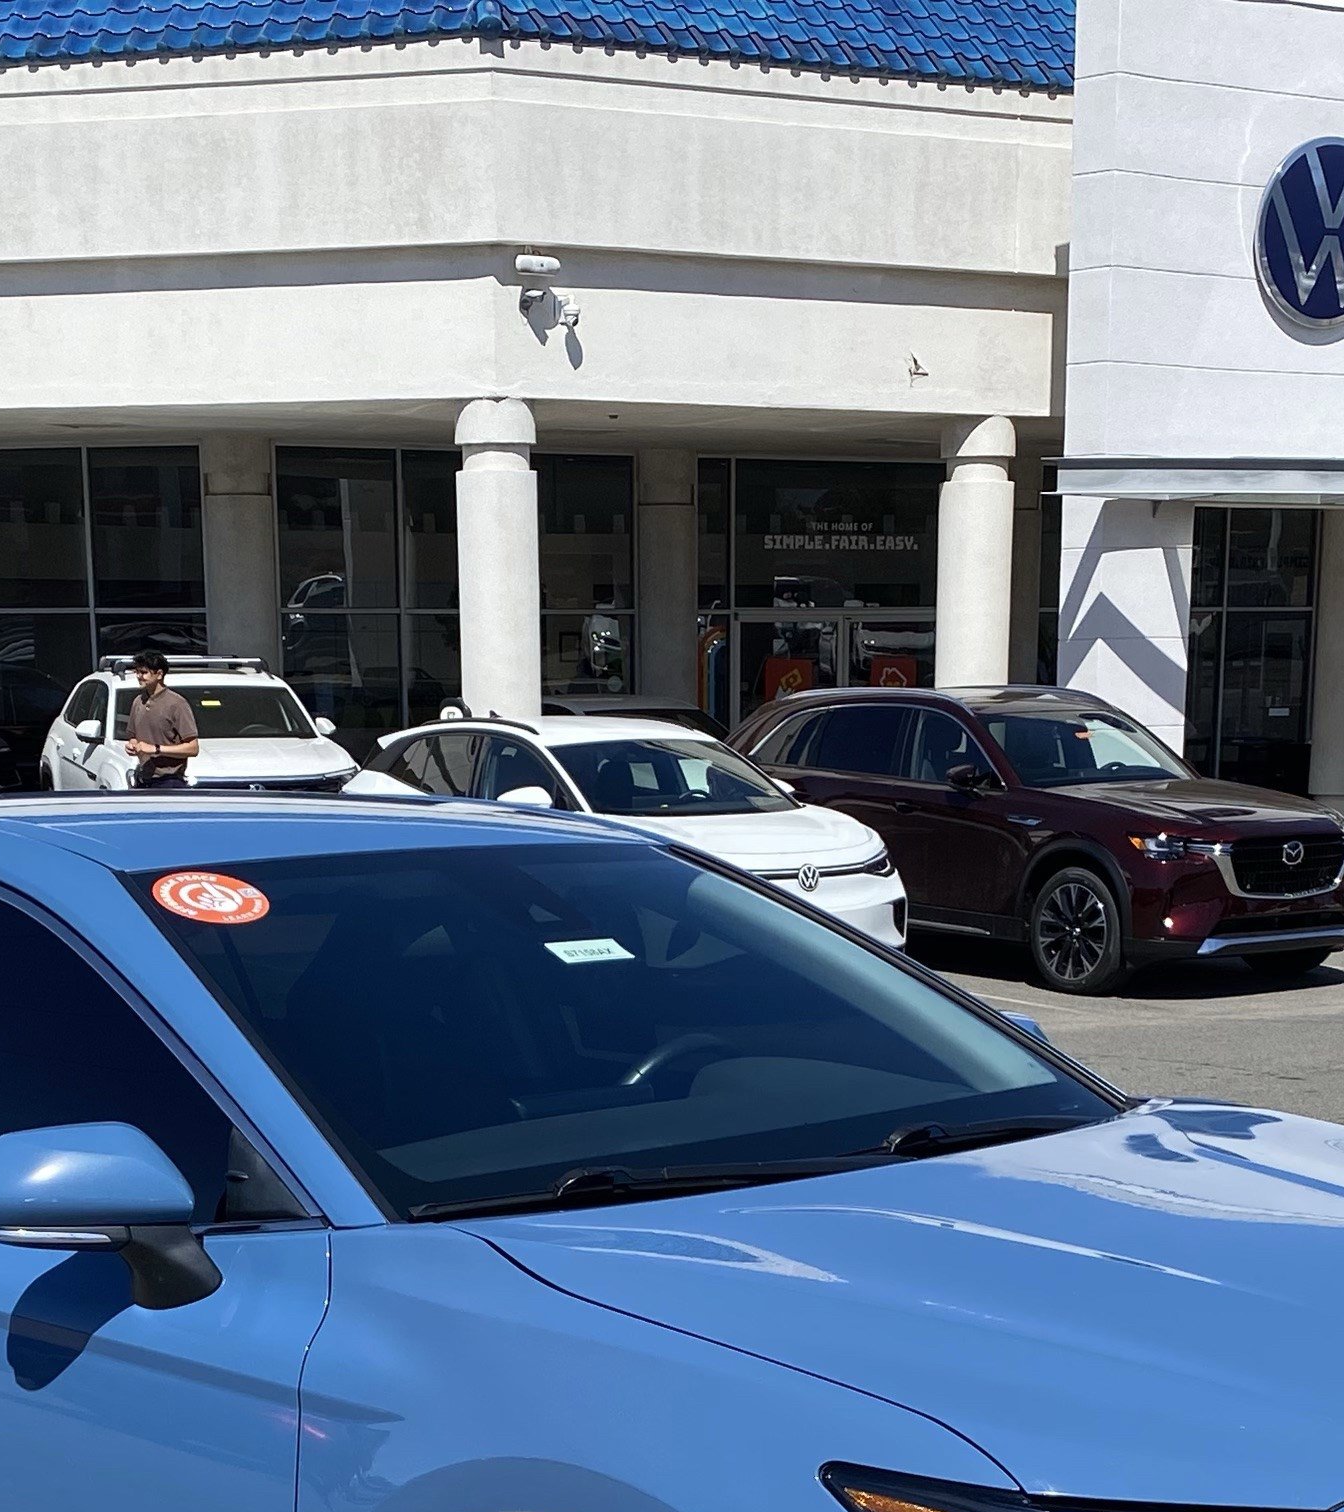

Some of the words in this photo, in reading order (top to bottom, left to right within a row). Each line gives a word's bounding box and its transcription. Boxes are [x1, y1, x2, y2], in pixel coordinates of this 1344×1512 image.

[812, 521, 829, 531] THE
[832, 522, 859, 531] HOME
[861, 522, 874, 531] OF
